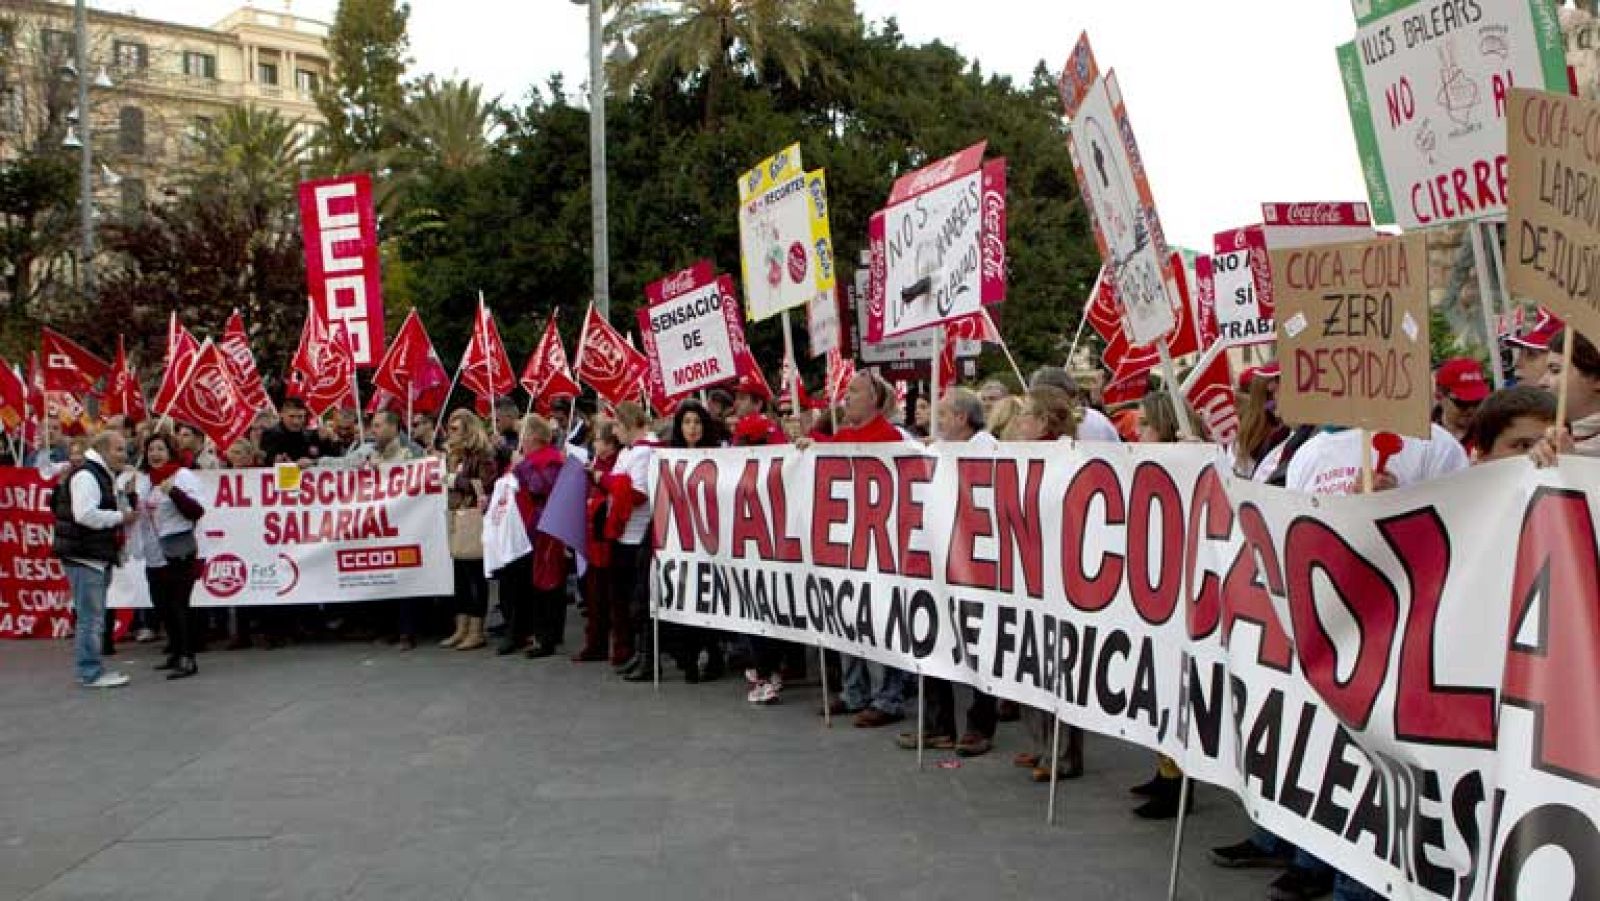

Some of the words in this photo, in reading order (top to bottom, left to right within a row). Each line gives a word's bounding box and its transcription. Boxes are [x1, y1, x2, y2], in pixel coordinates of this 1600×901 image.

[1385, 75, 1416, 129] NO
[1412, 155, 1508, 223] CIERRE
[1212, 253, 1238, 274] NO
[1286, 242, 1409, 291] COCA-COLA
[1219, 319, 1276, 339] TRAB
[1322, 292, 1393, 339] ZERO
[683, 329, 704, 351] DE
[672, 356, 720, 386] MORIR
[1295, 345, 1413, 400] DESPIDOS
[214, 474, 253, 508] AL
[263, 506, 398, 545] SALARIAL
[651, 458, 718, 556] NO
[732, 457, 803, 562] AL
[811, 456, 938, 580] ERE
[946, 458, 1044, 599] EN
[696, 561, 731, 617] EN
[731, 565, 876, 653] MALLORCA
[885, 588, 939, 660] NO
[949, 595, 984, 670] SE
